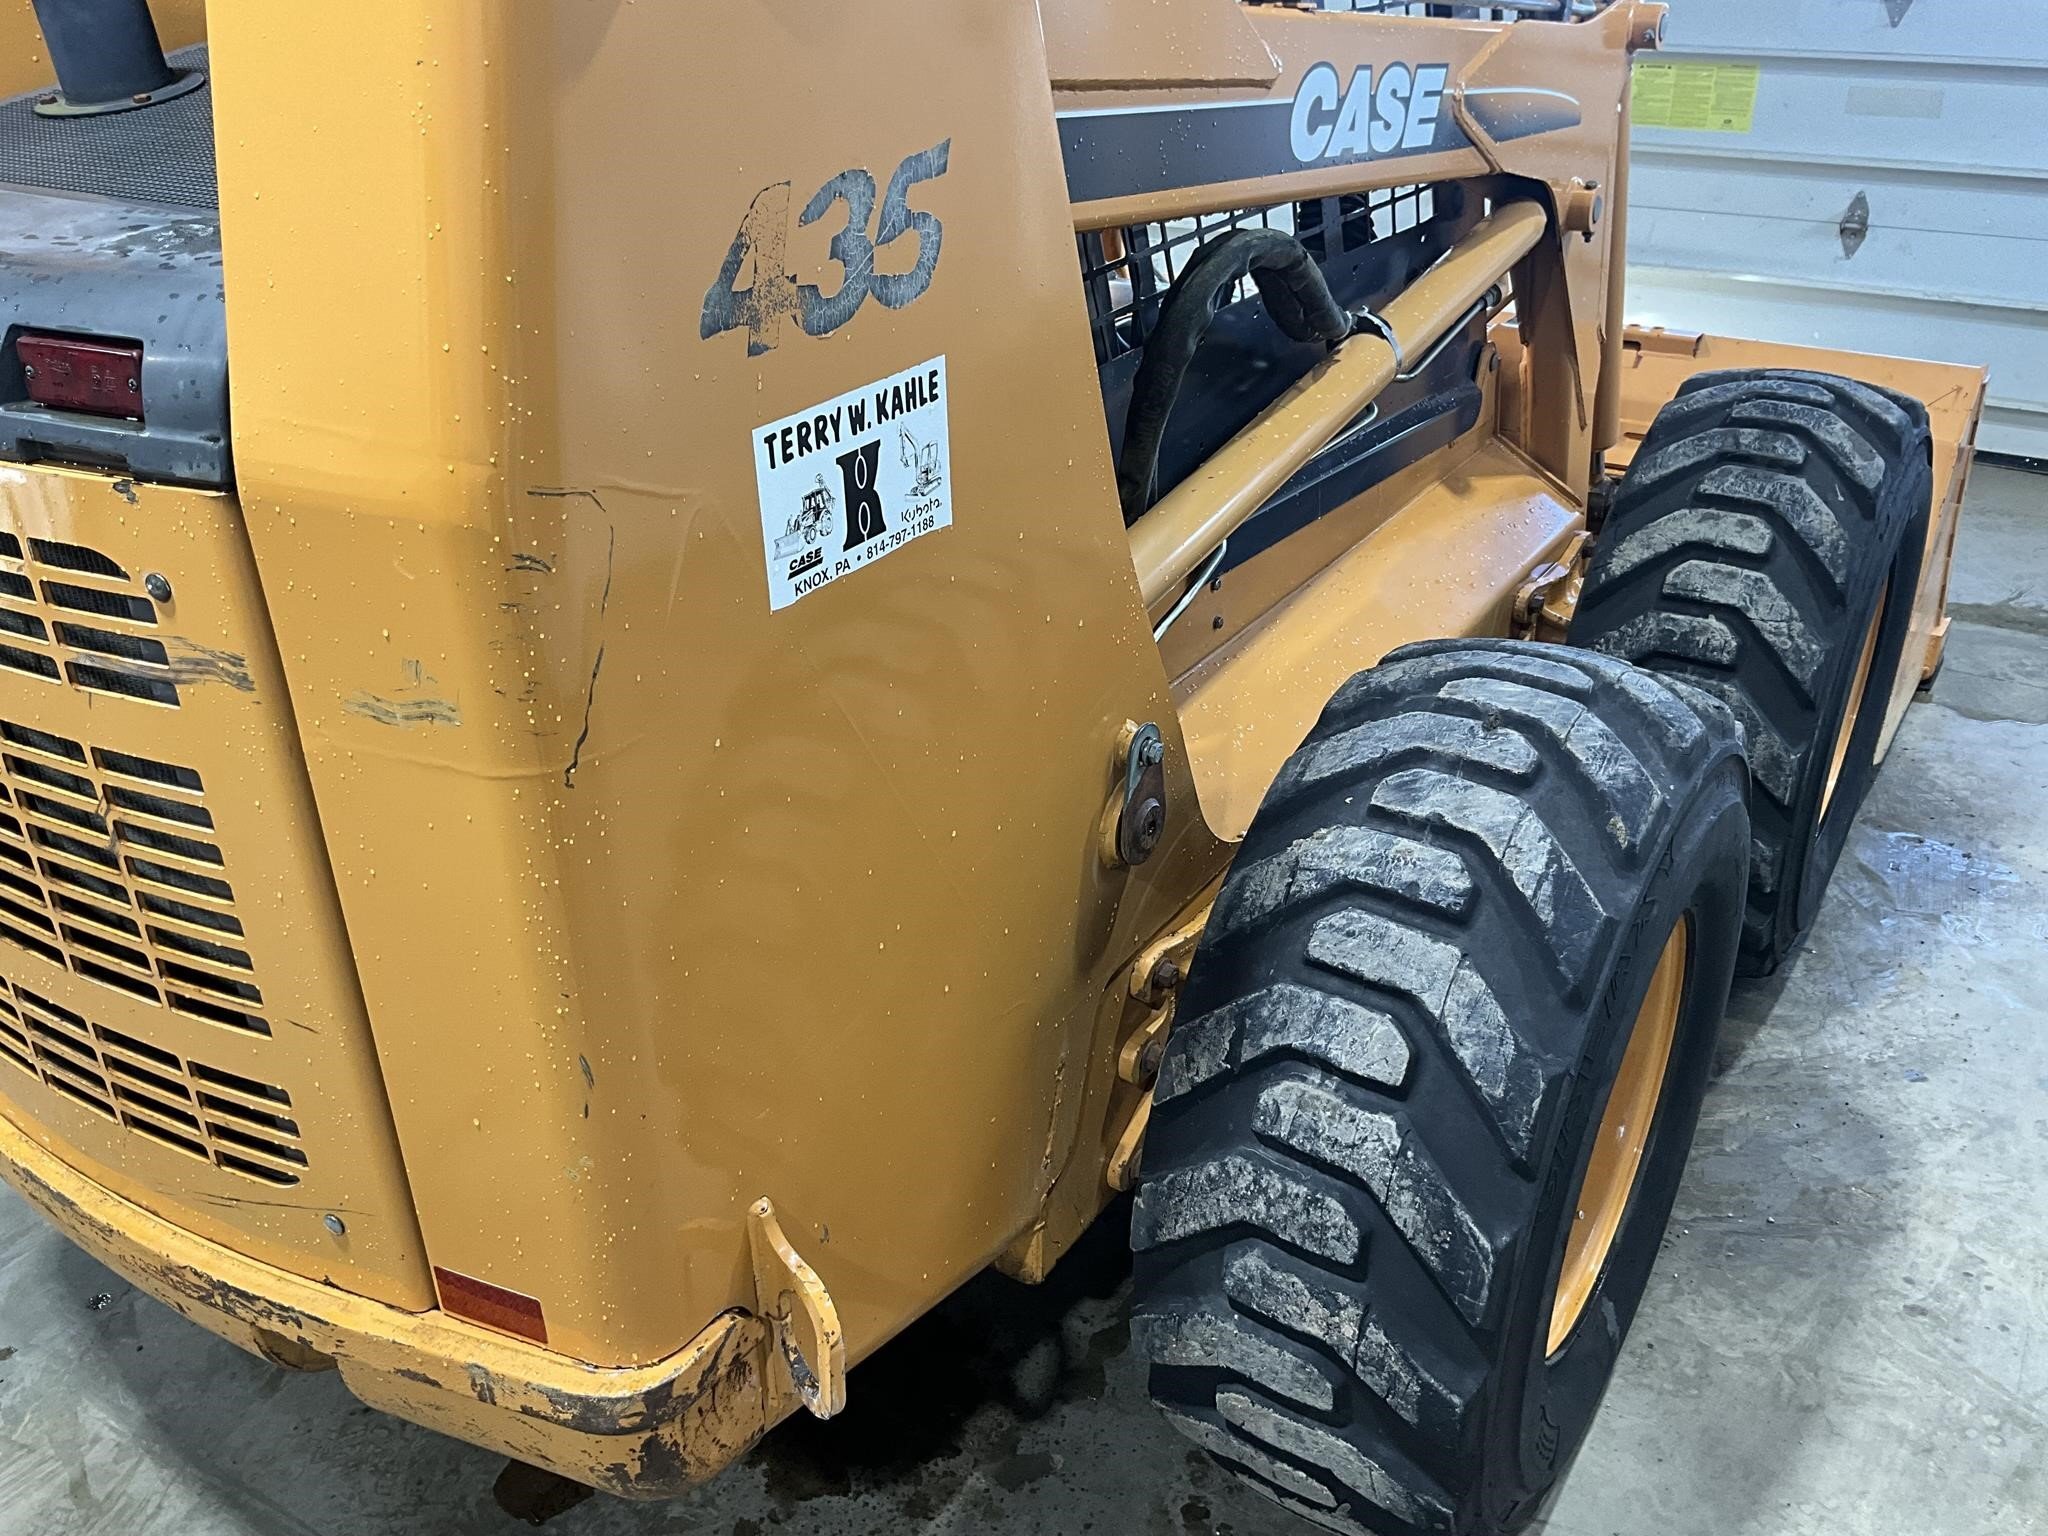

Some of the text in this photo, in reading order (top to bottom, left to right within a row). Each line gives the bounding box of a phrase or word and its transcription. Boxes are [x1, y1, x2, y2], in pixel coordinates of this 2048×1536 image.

[1290, 62, 1448, 162] CASE
[700, 137, 951, 358] 435
[764, 369, 939, 469] TERRY W. KAHLE
[901, 498, 941, 522] Kubota
[789, 547, 823, 571] CASE
[794, 515, 934, 596] KNOX, PA 814-797-1188
